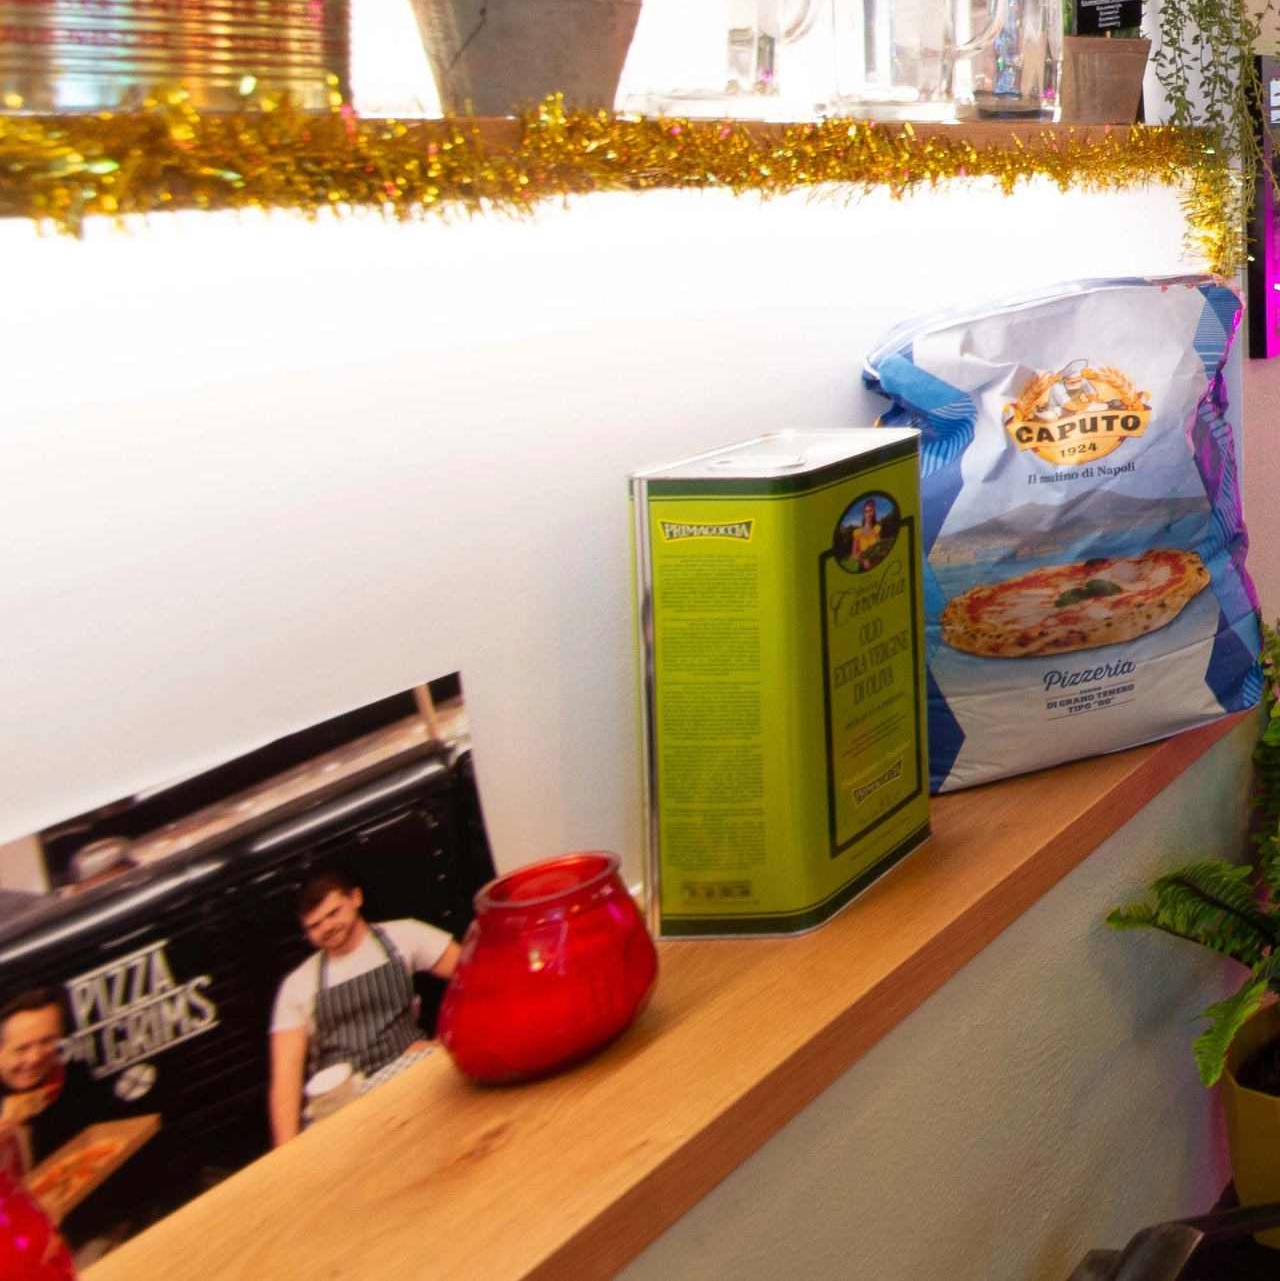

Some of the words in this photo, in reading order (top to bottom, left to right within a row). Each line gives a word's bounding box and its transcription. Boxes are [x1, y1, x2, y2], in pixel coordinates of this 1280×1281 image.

[1015, 414, 1141, 444] CAPUTO
[1060, 442, 1098, 458] 1924
[1040, 469, 1079, 484] mulino
[1081, 468, 1094, 478] di
[1097, 461, 1135, 477] Napoli
[663, 522, 749, 539] PRIMAGOCCIA
[830, 560, 906, 627] Carolina
[859, 618, 883, 646] OLIO
[834, 652, 868, 689] EXTRA
[868, 629, 909, 668] VERGINE
[865, 665, 894, 697] OLIVA
[1043, 659, 1136, 692] Pizzeria
[1046, 701, 1057, 709] DI
[1059, 694, 1095, 707] GRANO
[1096, 684, 1135, 699] TENERO
[1067, 702, 1092, 713] TIPO
[68, 948, 177, 1031] PIZZA
